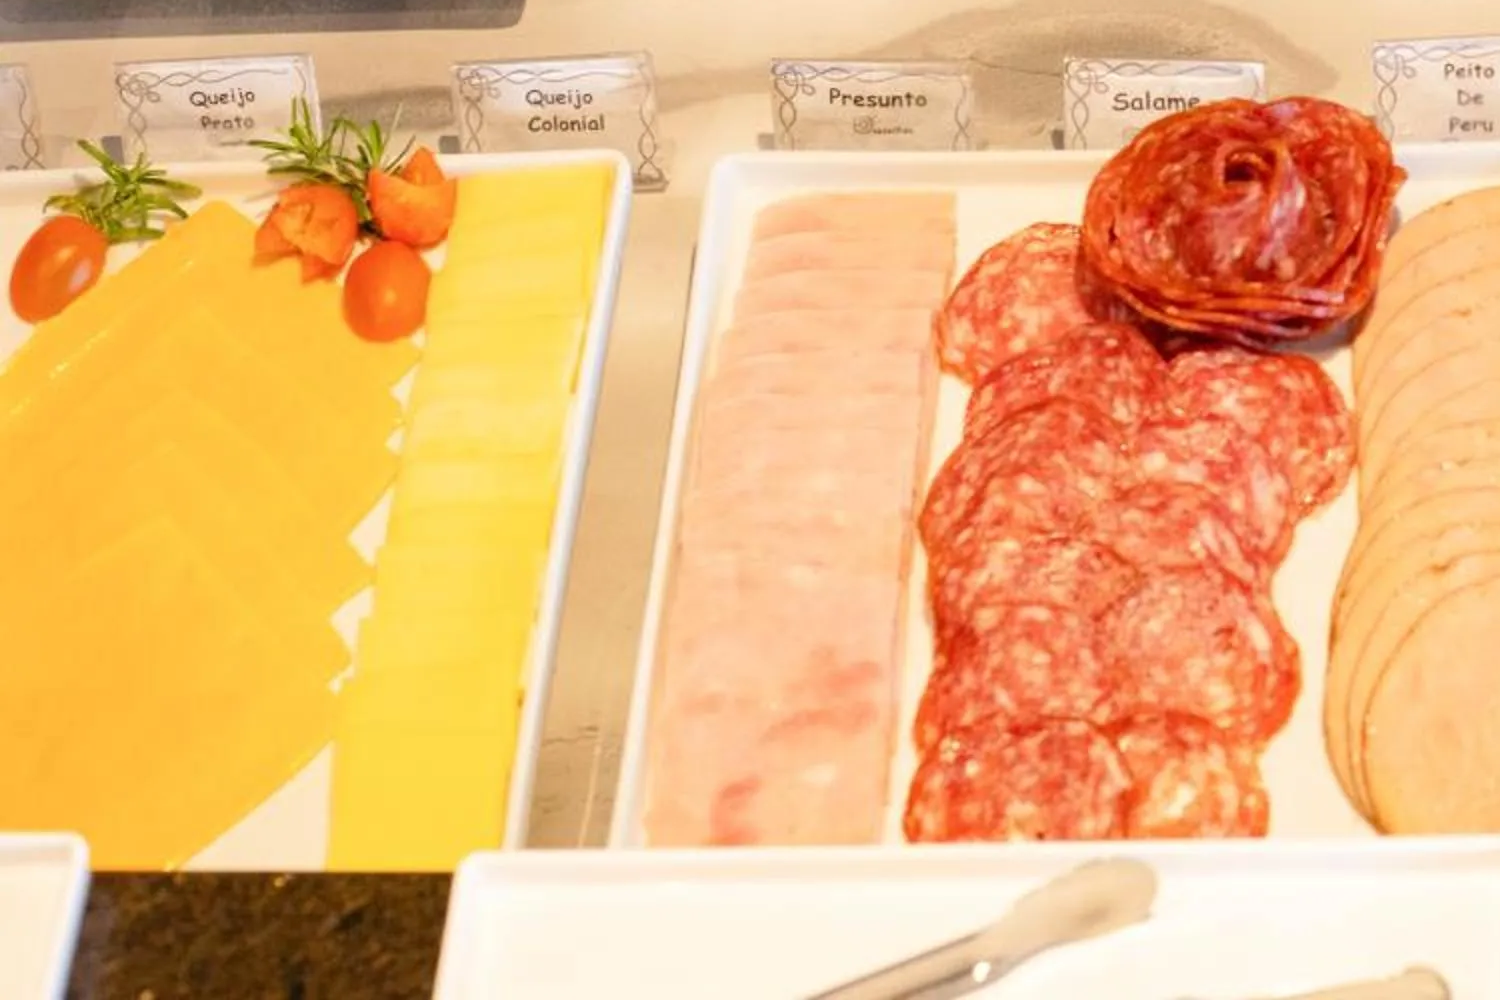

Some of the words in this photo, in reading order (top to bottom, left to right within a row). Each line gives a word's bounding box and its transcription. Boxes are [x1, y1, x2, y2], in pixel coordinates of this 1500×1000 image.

[1443, 63, 1495, 80] Peito
[189, 87, 256, 108] Queijo
[525, 89, 594, 109] Queijo
[828, 87, 928, 108] Presunto
[1112, 91, 1201, 113] Salame
[1456, 89, 1485, 107] De
[201, 115, 256, 130] Prato
[527, 114, 606, 133] Colonial
[1449, 117, 1494, 133] Peru
